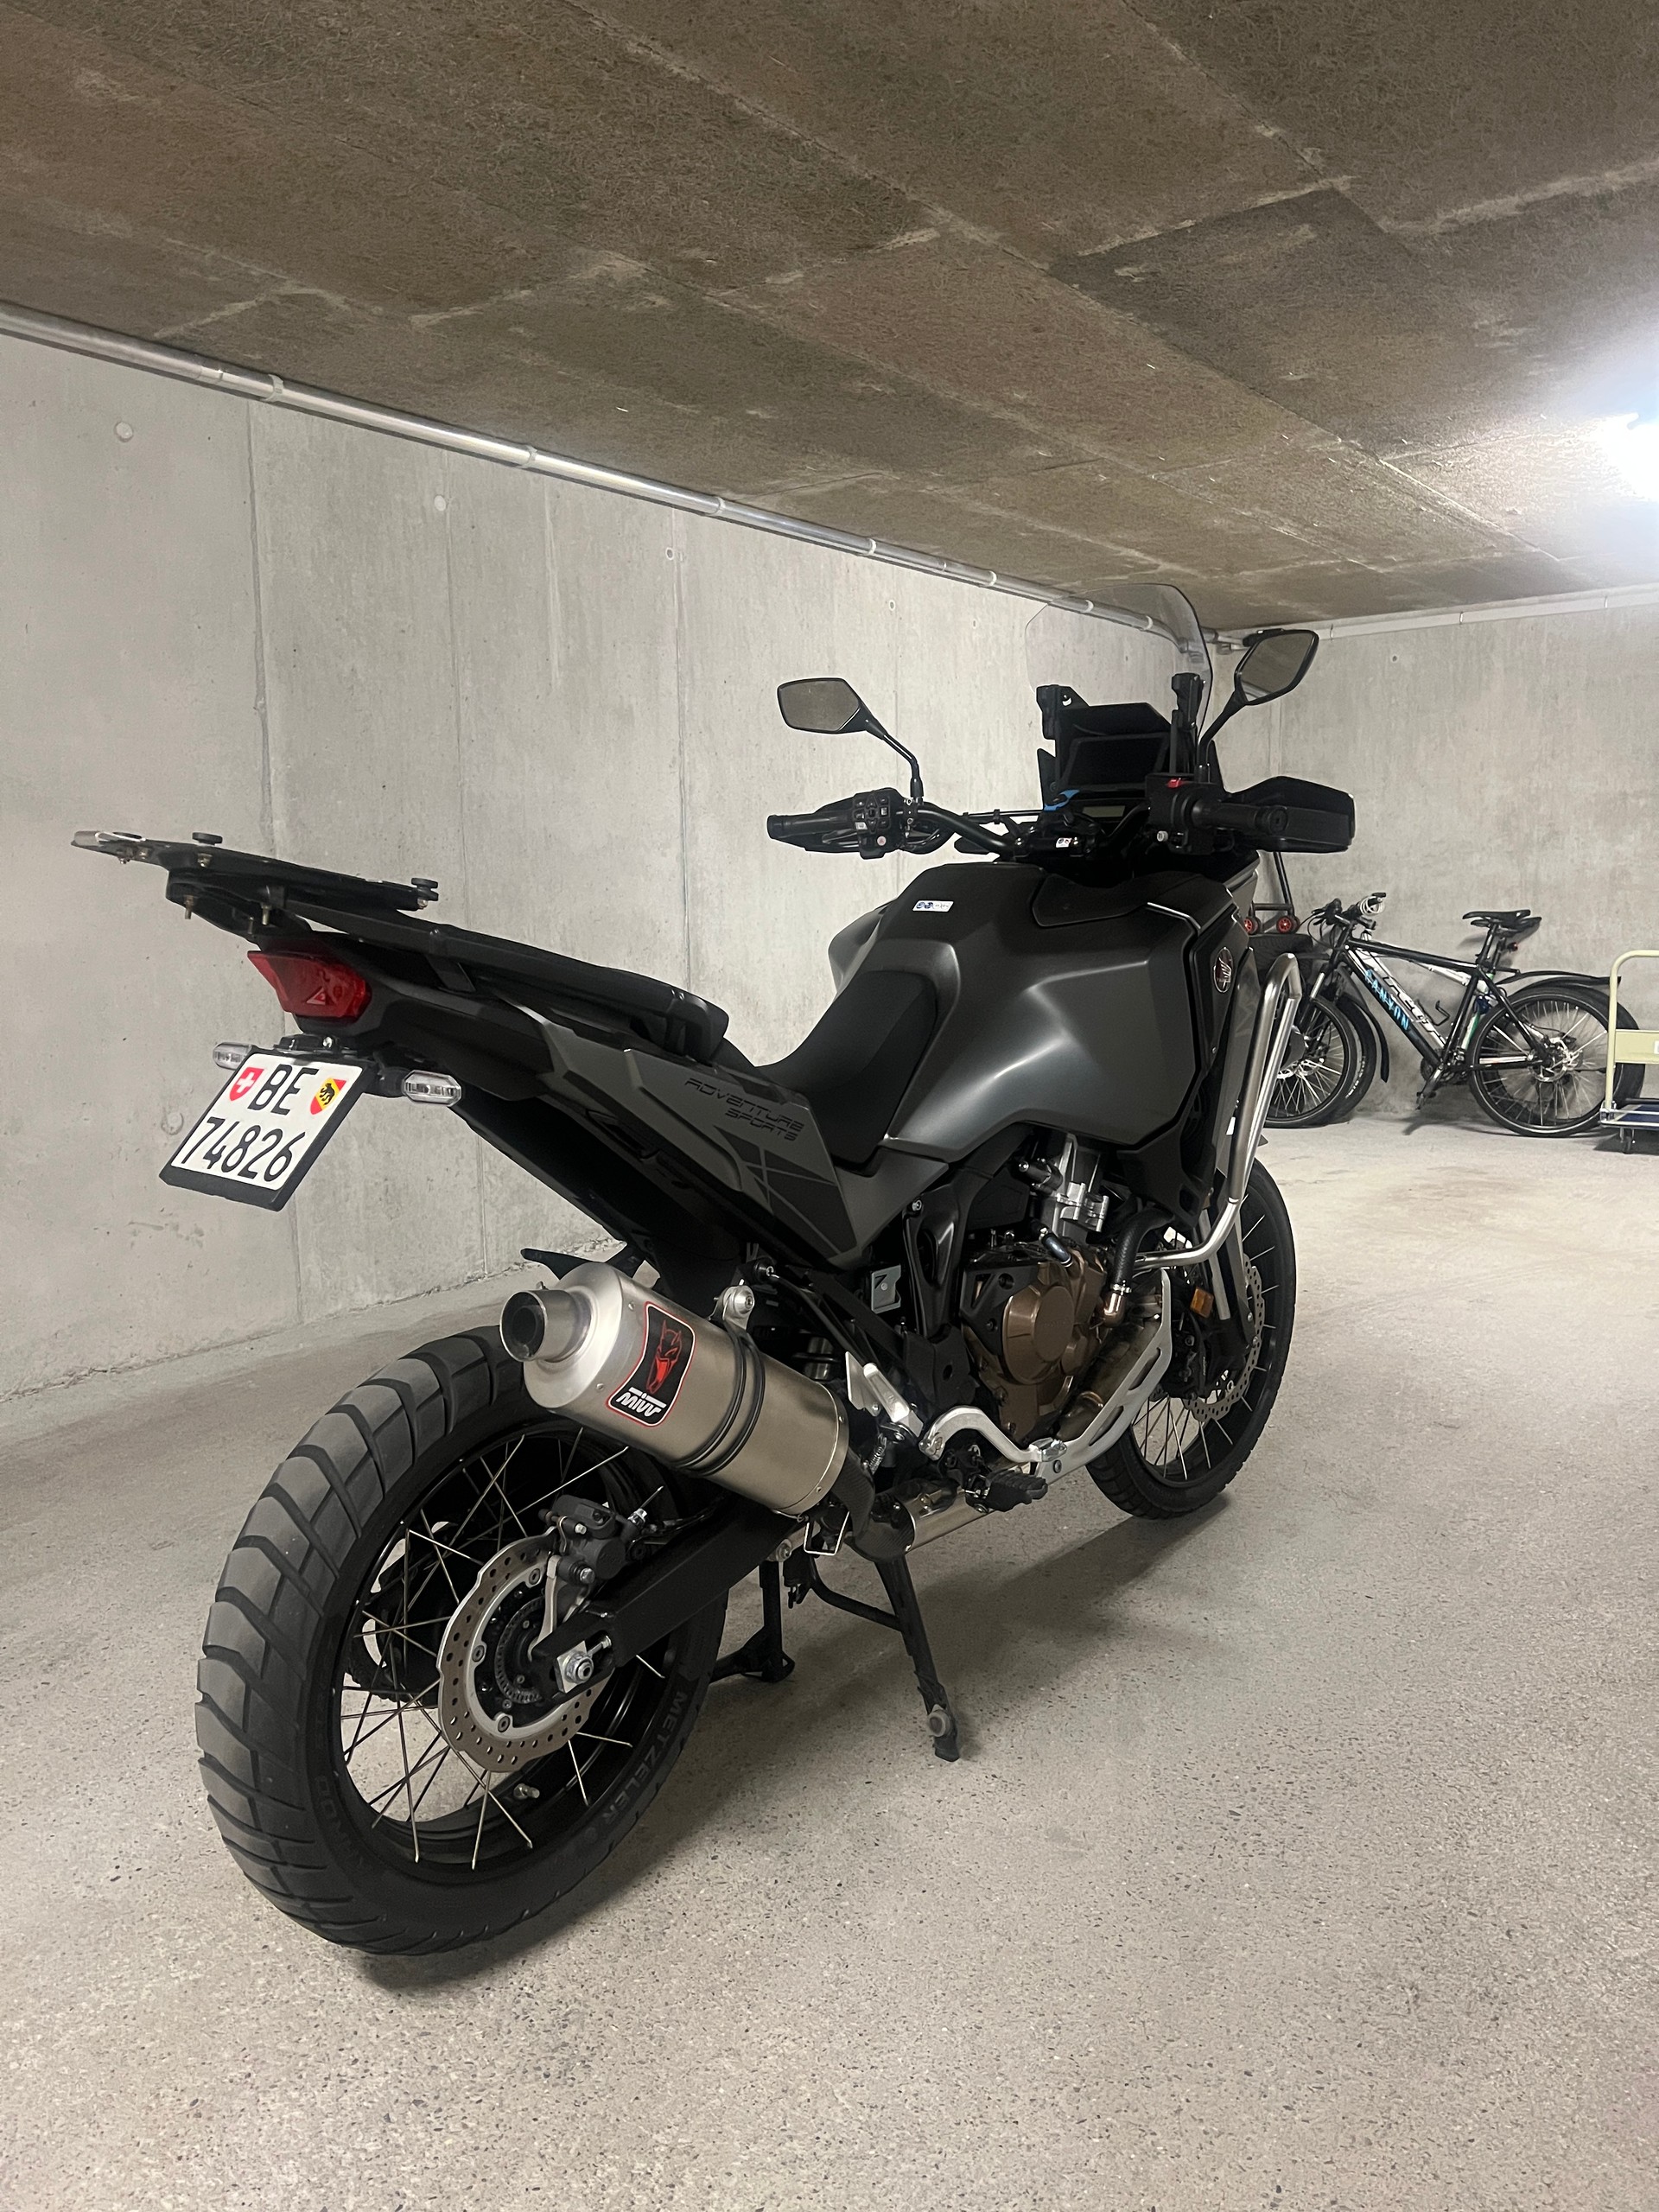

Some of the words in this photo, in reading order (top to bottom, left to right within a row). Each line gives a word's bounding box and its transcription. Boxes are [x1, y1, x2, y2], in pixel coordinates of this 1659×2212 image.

[1364, 968, 1411, 1031] CANYON
[247, 1064, 320, 1116] BE
[684, 1077, 805, 1133] ADVENTURE
[180, 1116, 306, 1182] 74826
[724, 1107, 798, 1141] SPORTS
[602, 1691, 688, 1825] METZELER
